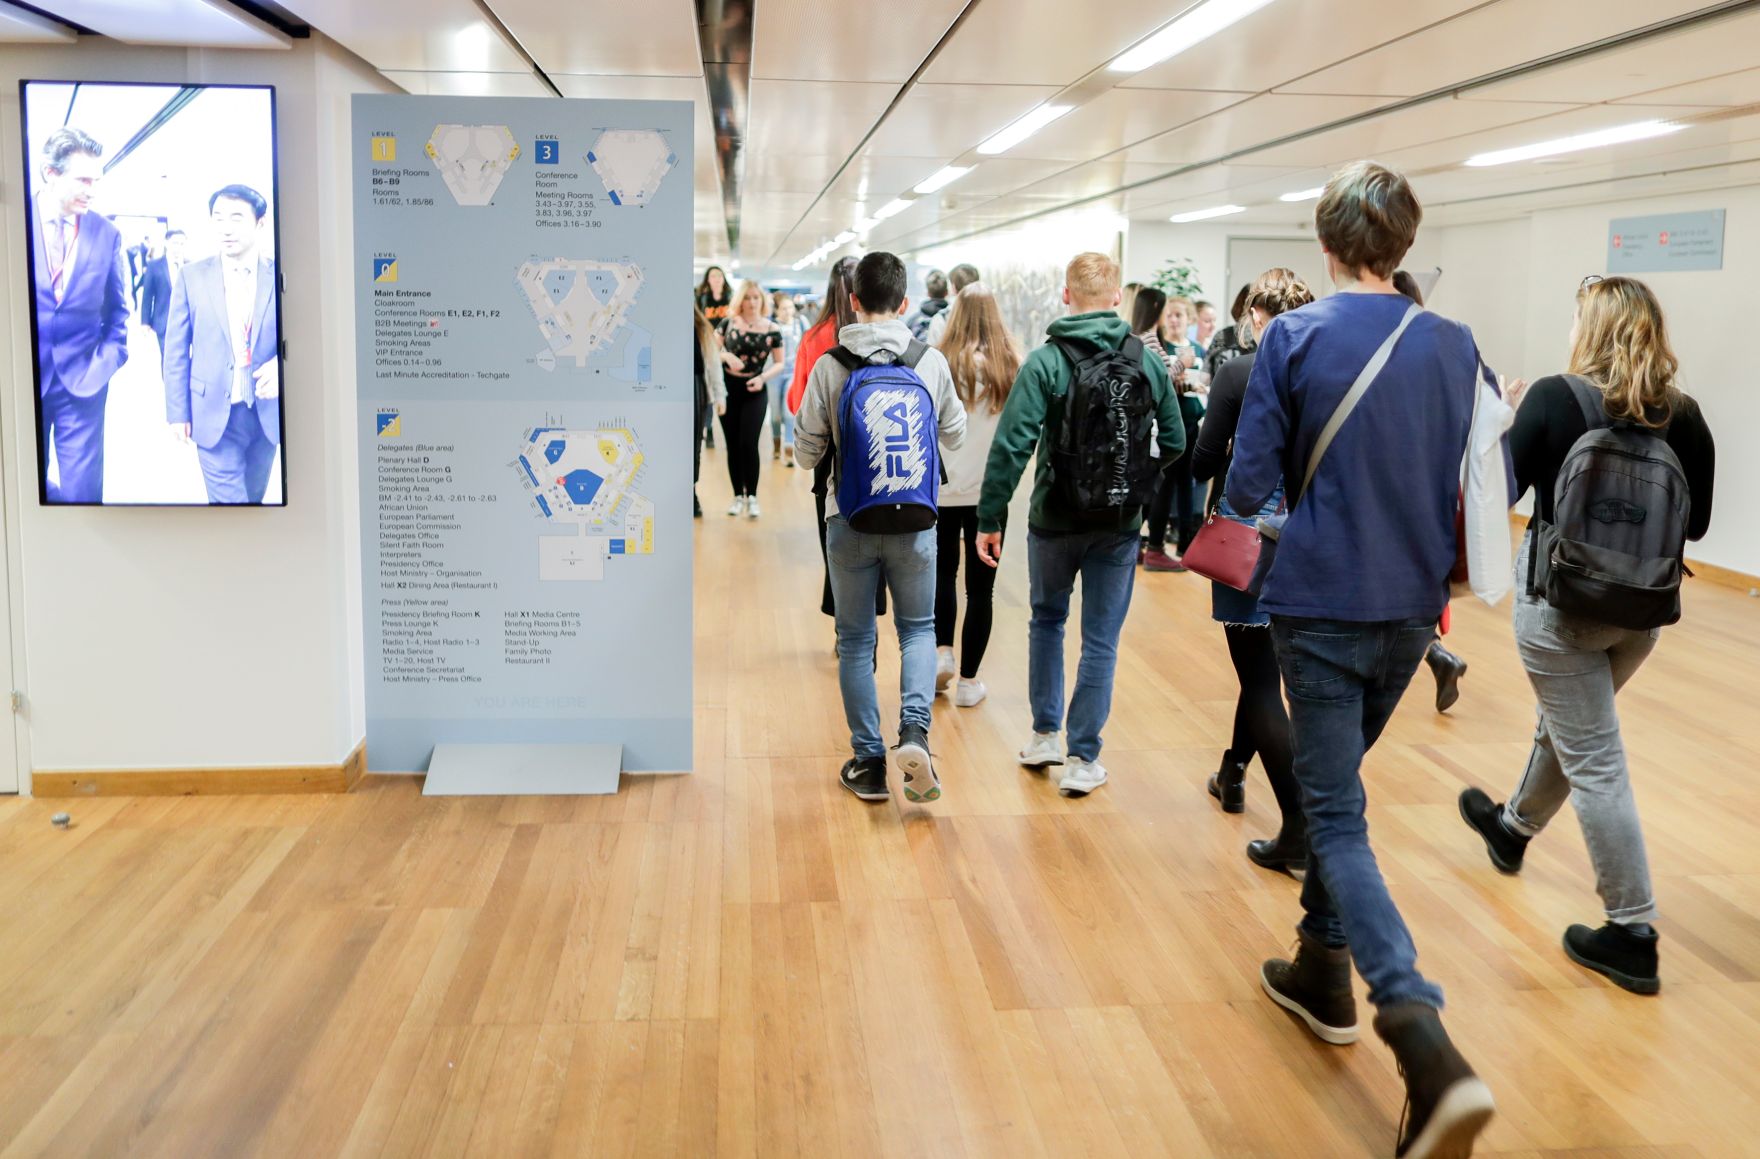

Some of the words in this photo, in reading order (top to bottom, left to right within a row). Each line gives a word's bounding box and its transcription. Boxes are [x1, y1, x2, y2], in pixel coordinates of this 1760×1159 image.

[379, 142, 386, 158] 1
[542, 145, 551, 160] 3
[372, 168, 401, 178] Briefing
[535, 171, 578, 179] Conference
[372, 188, 399, 196] Rooms
[536, 191, 565, 200] Meeting
[382, 263, 390, 279] 0
[393, 320, 427, 328] Meetings
[375, 329, 412, 337] Delegates
[414, 330, 442, 338] Lounge
[376, 339, 408, 348] Smoking
[477, 371, 510, 380] Techgate
[883, 402, 912, 478] FILA
[377, 444, 414, 452] Delegates
[416, 444, 434, 452] (Blue
[378, 456, 405, 464] Plenary
[378, 475, 415, 484] Delegates
[417, 476, 444, 484] Lounge
[379, 485, 410, 493] Smoking
[380, 522, 414, 530] European
[380, 532, 416, 540] Delegates
[380, 560, 420, 568] Presidency
[436, 570, 482, 578] Organisation
[409, 582, 431, 590] Dining
[451, 582, 492, 590] (Restaurant
[403, 599, 428, 607] (Yellow
[382, 610, 420, 619] Presidency
[422, 610, 450, 619] Briefing
[505, 620, 532, 628] Briefing
[382, 629, 414, 637] Smoking
[505, 648, 528, 656] Family
[474, 696, 506, 708] YOU
[511, 696, 543, 708] ARE
[546, 696, 586, 708] HERE
